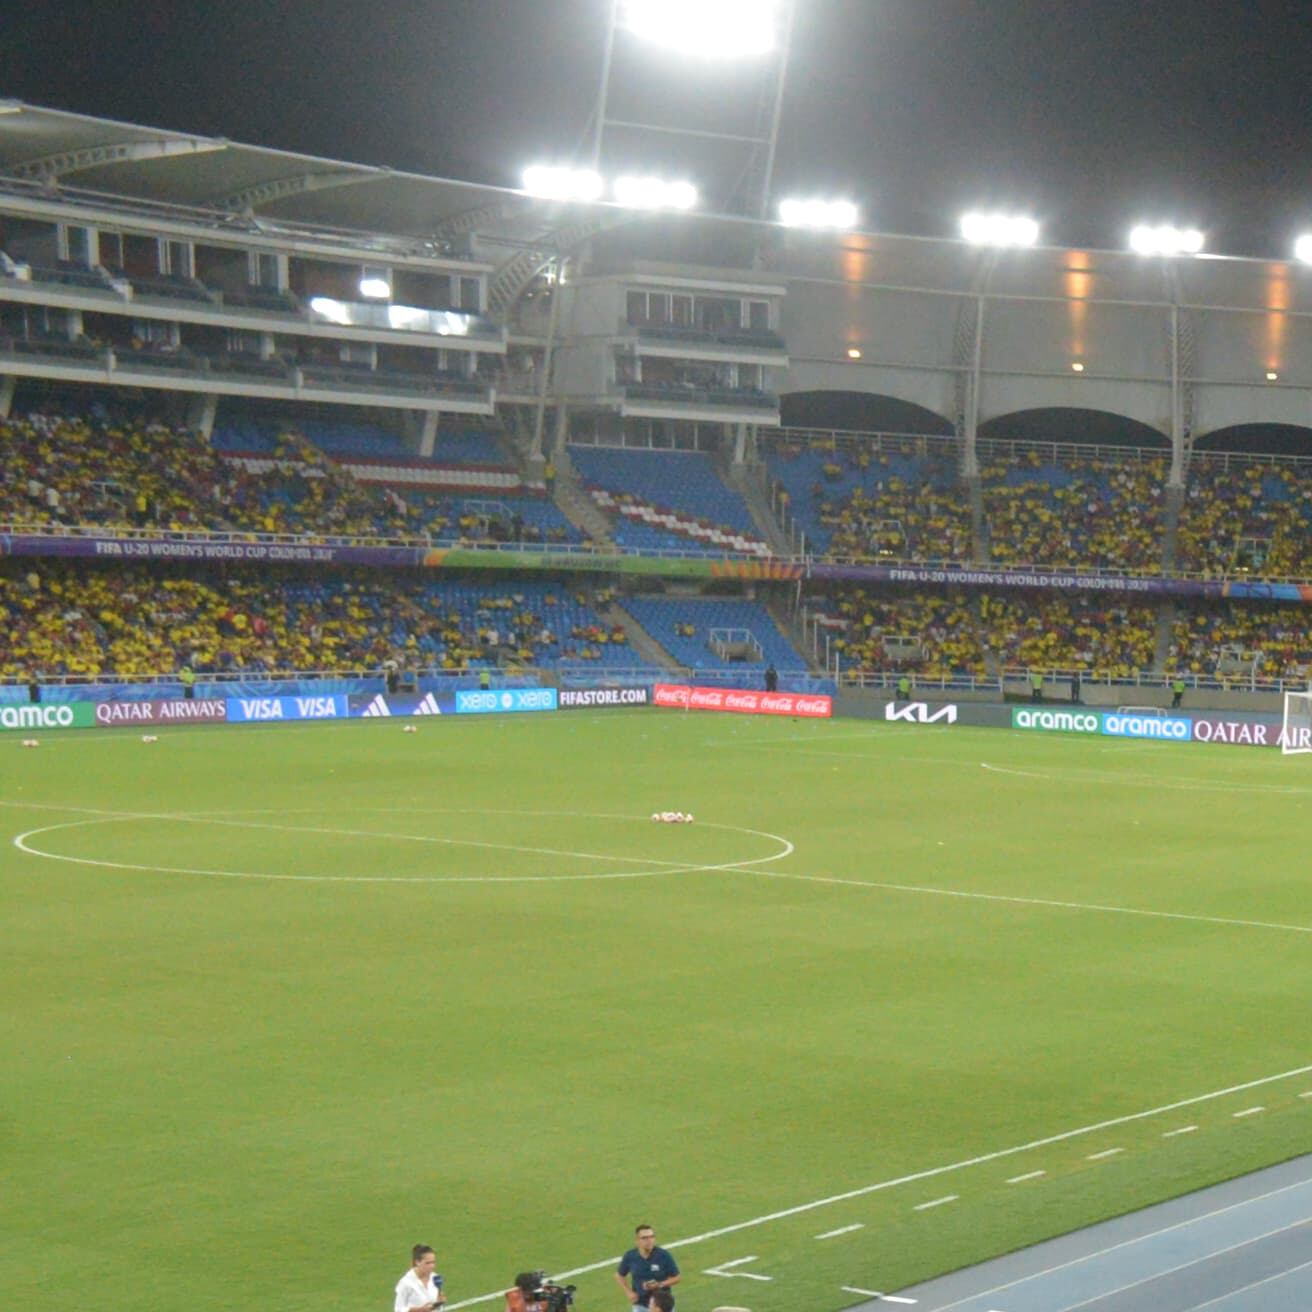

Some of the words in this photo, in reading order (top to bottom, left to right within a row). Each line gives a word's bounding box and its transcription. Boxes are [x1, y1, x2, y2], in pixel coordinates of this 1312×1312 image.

[96, 542, 122, 554] FIFA
[124, 543, 149, 555] U-20
[150, 544, 203, 557] WOMEN'S
[205, 545, 244, 558] WORLD
[246, 546, 268, 558] CUP
[890, 569, 917, 580] FIFA
[920, 571, 945, 582] U-20
[946, 572, 1003, 584] WOMEN'S
[1005, 574, 1048, 586] WORLD
[1051, 576, 1074, 587] CUP
[295, 696, 336, 717] VISA
[460, 692, 497, 708] xero
[560, 689, 647, 705] FIFASTORE.COM
[0, 705, 74, 728] amco
[97, 702, 153, 723] QATAR
[160, 699, 225, 720] AIRWAYS
[240, 698, 283, 719] VISA
[885, 702, 958, 724] KIA
[1016, 709, 1098, 731] aramco
[1105, 715, 1187, 738] aramco
[1194, 720, 1267, 745] QATAR
